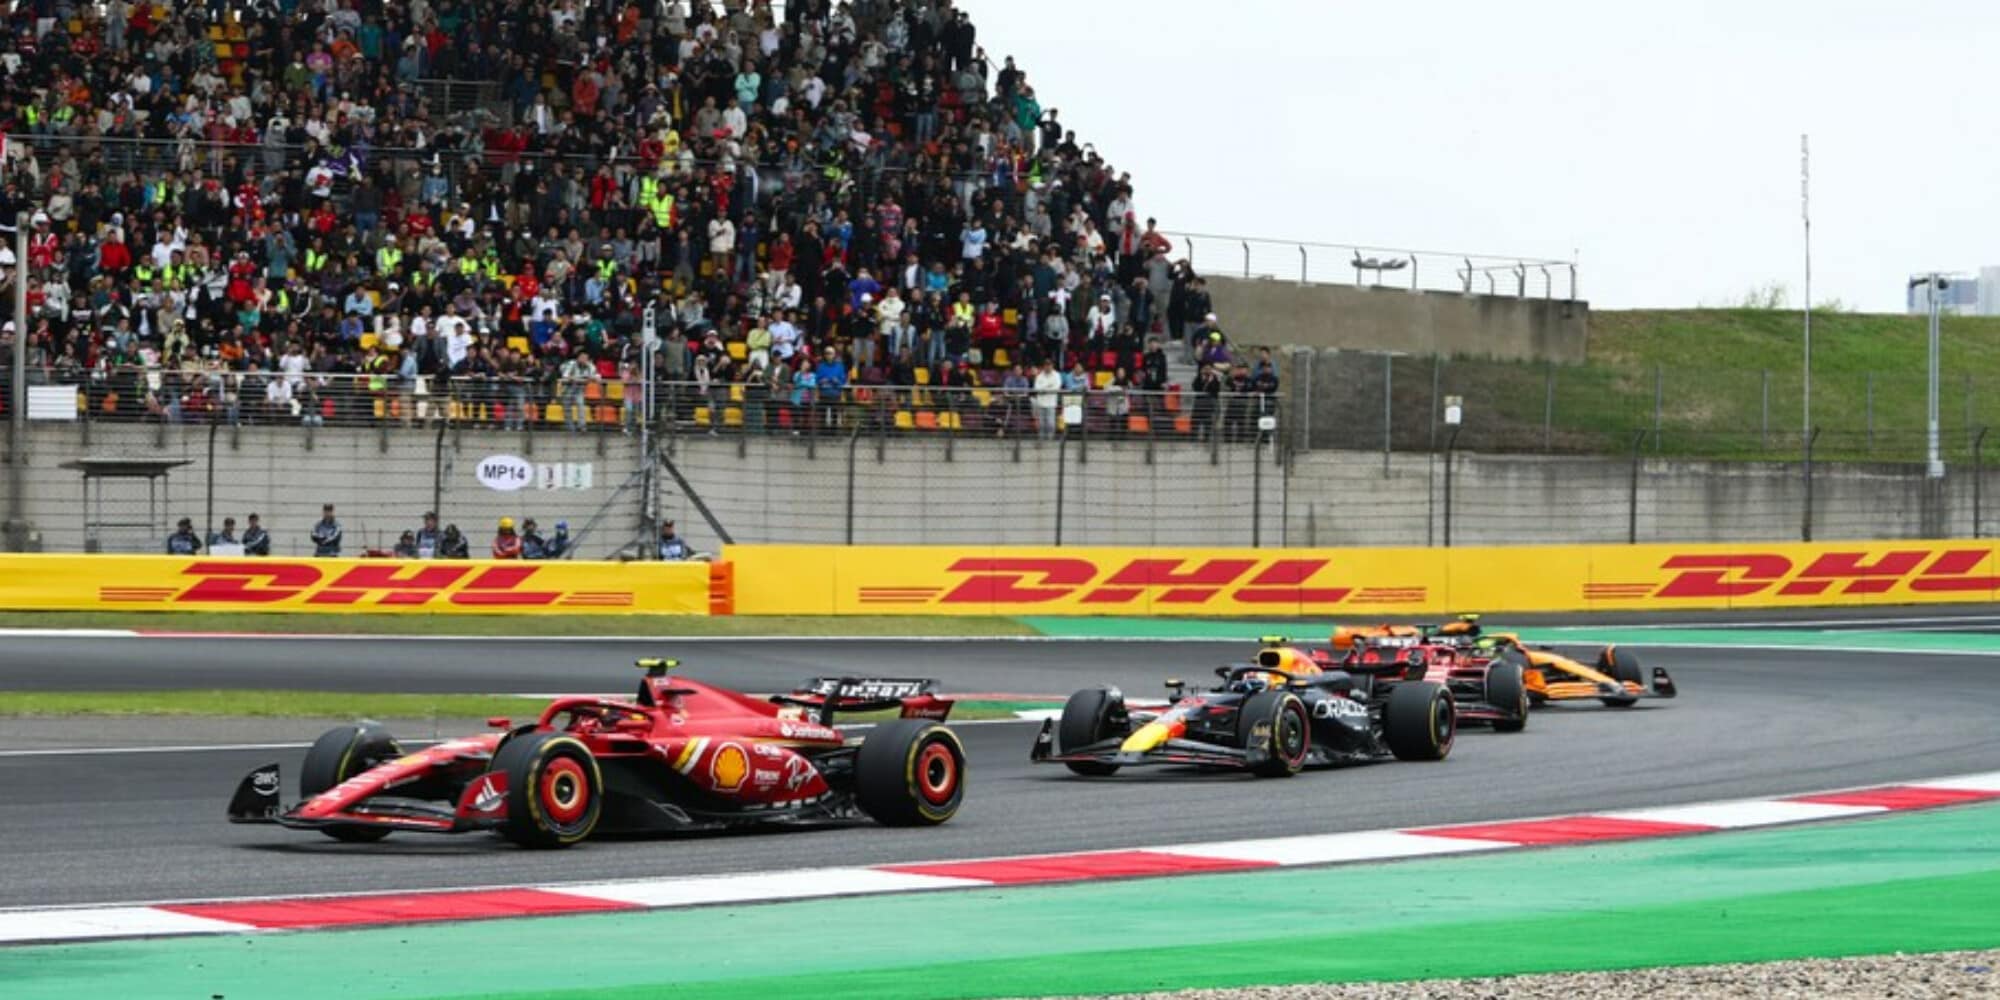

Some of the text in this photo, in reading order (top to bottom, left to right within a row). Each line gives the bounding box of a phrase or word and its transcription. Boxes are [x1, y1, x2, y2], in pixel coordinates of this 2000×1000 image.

[484, 464, 525, 480] MP14
[176, 561, 562, 606] DHL
[941, 558, 1350, 603] DHL
[1656, 550, 2000, 597] DHL
